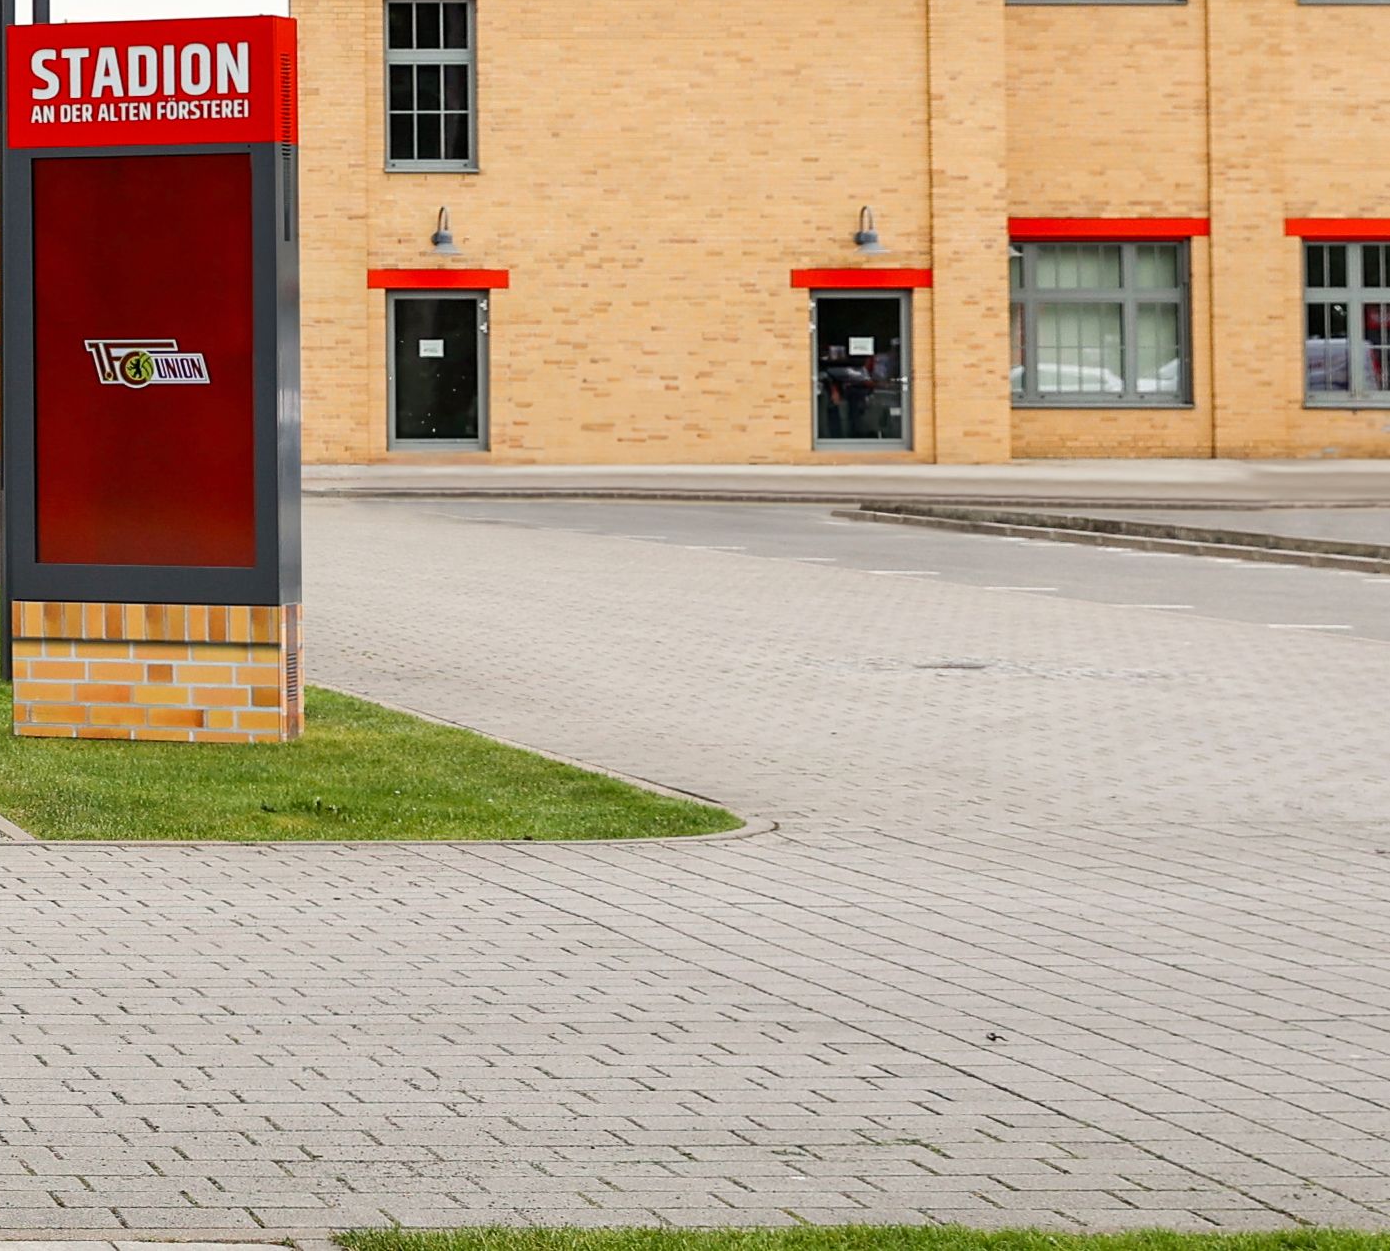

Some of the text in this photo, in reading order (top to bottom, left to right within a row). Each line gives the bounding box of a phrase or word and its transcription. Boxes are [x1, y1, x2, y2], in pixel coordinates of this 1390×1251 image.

[31, 42, 249, 100] STADION
[31, 97, 250, 124] AN DER ALTEN FÖRSTEREI
[154, 357, 205, 379] UNION
